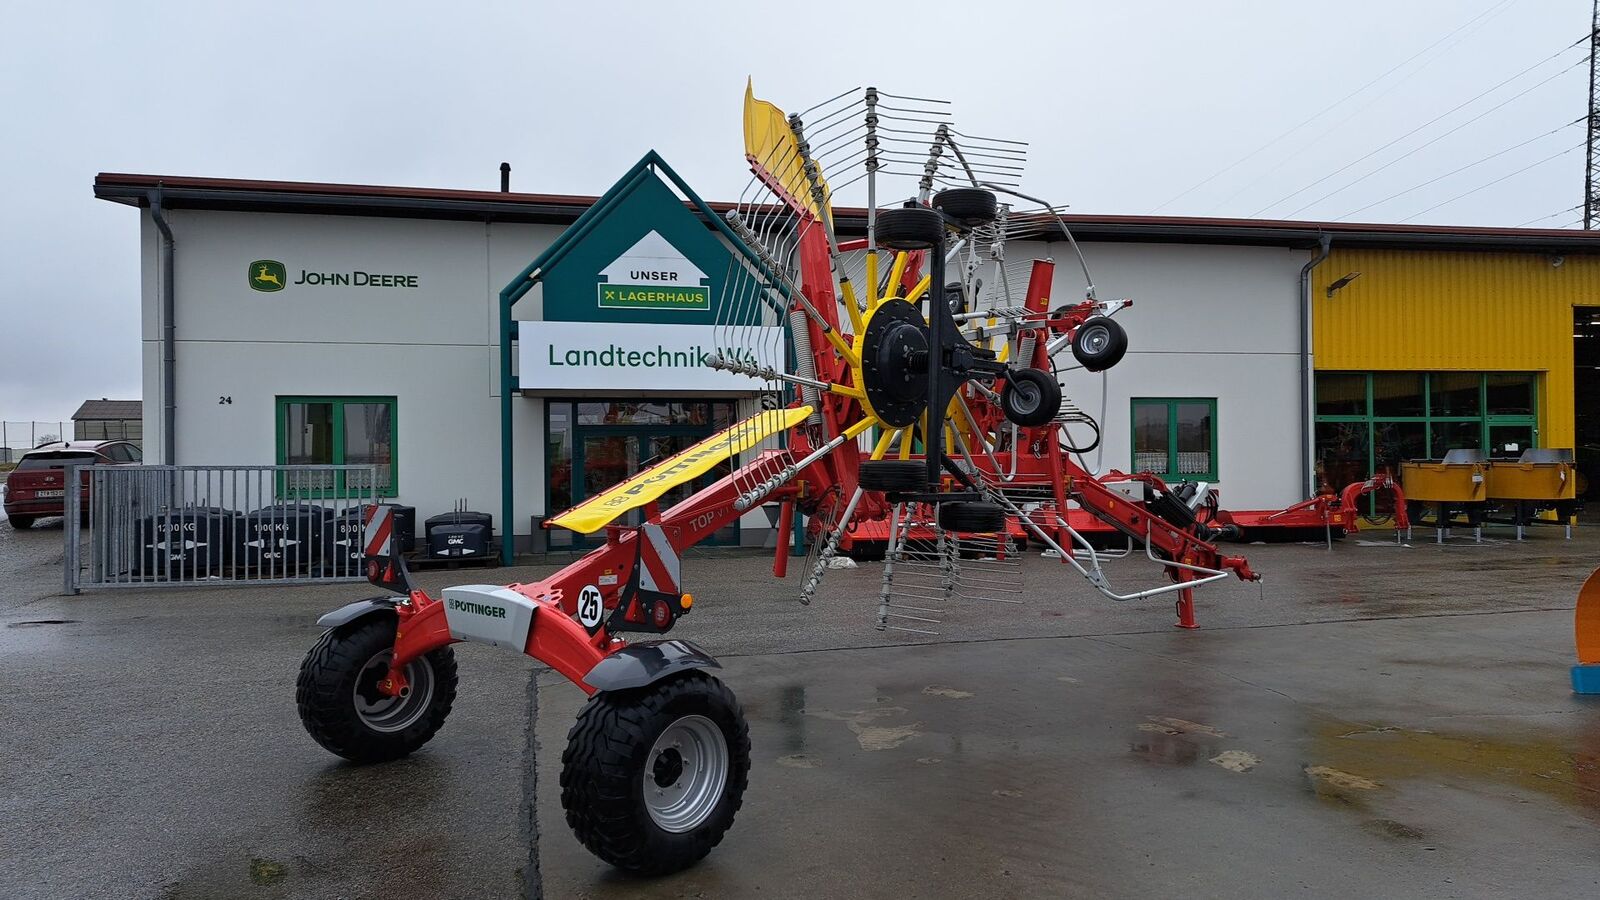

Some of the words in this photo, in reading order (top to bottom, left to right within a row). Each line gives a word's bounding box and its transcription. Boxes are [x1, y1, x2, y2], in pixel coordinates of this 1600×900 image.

[294, 269, 350, 286] JOHN
[353, 271, 419, 288] DEERE
[630, 270, 678, 281] UNSER
[619, 291, 704, 303] LAGERHAUS
[548, 344, 710, 368] Landtechnik
[218, 396, 232, 405] 24
[180, 523, 197, 532] KG
[275, 523, 290, 532] KG
[689, 511, 714, 533] TOP
[580, 589, 600, 621] 25
